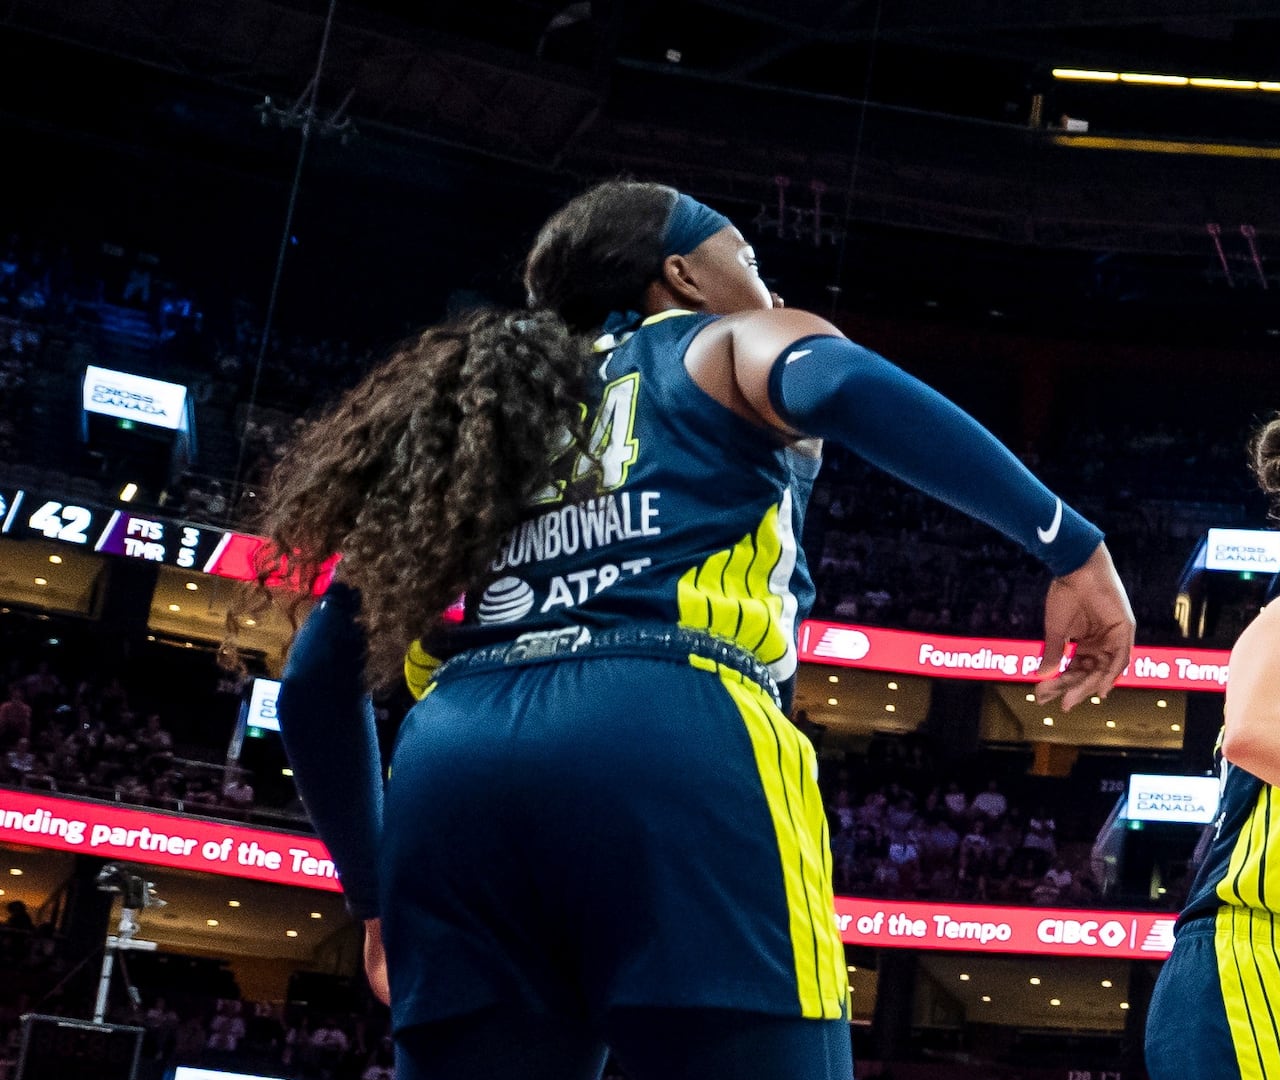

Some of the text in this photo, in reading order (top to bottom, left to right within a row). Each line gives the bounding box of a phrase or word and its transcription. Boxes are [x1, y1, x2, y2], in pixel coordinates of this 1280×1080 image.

[28, 501, 92, 544] 42
[126, 518, 200, 547] FTS 3
[492, 492, 661, 571] UNBOWALE
[176, 548, 196, 567] 5
[540, 557, 651, 613] AT&T
[919, 644, 1018, 675] Founding
[1135, 654, 1230, 685] the Temp
[0, 808, 86, 844] nding
[90, 825, 197, 857] partner
[202, 838, 233, 862] of
[238, 842, 282, 870] the
[858, 911, 885, 935] of
[887, 912, 928, 938] the
[932, 915, 1012, 944] Tempo
[1037, 919, 1099, 945] CIBC
